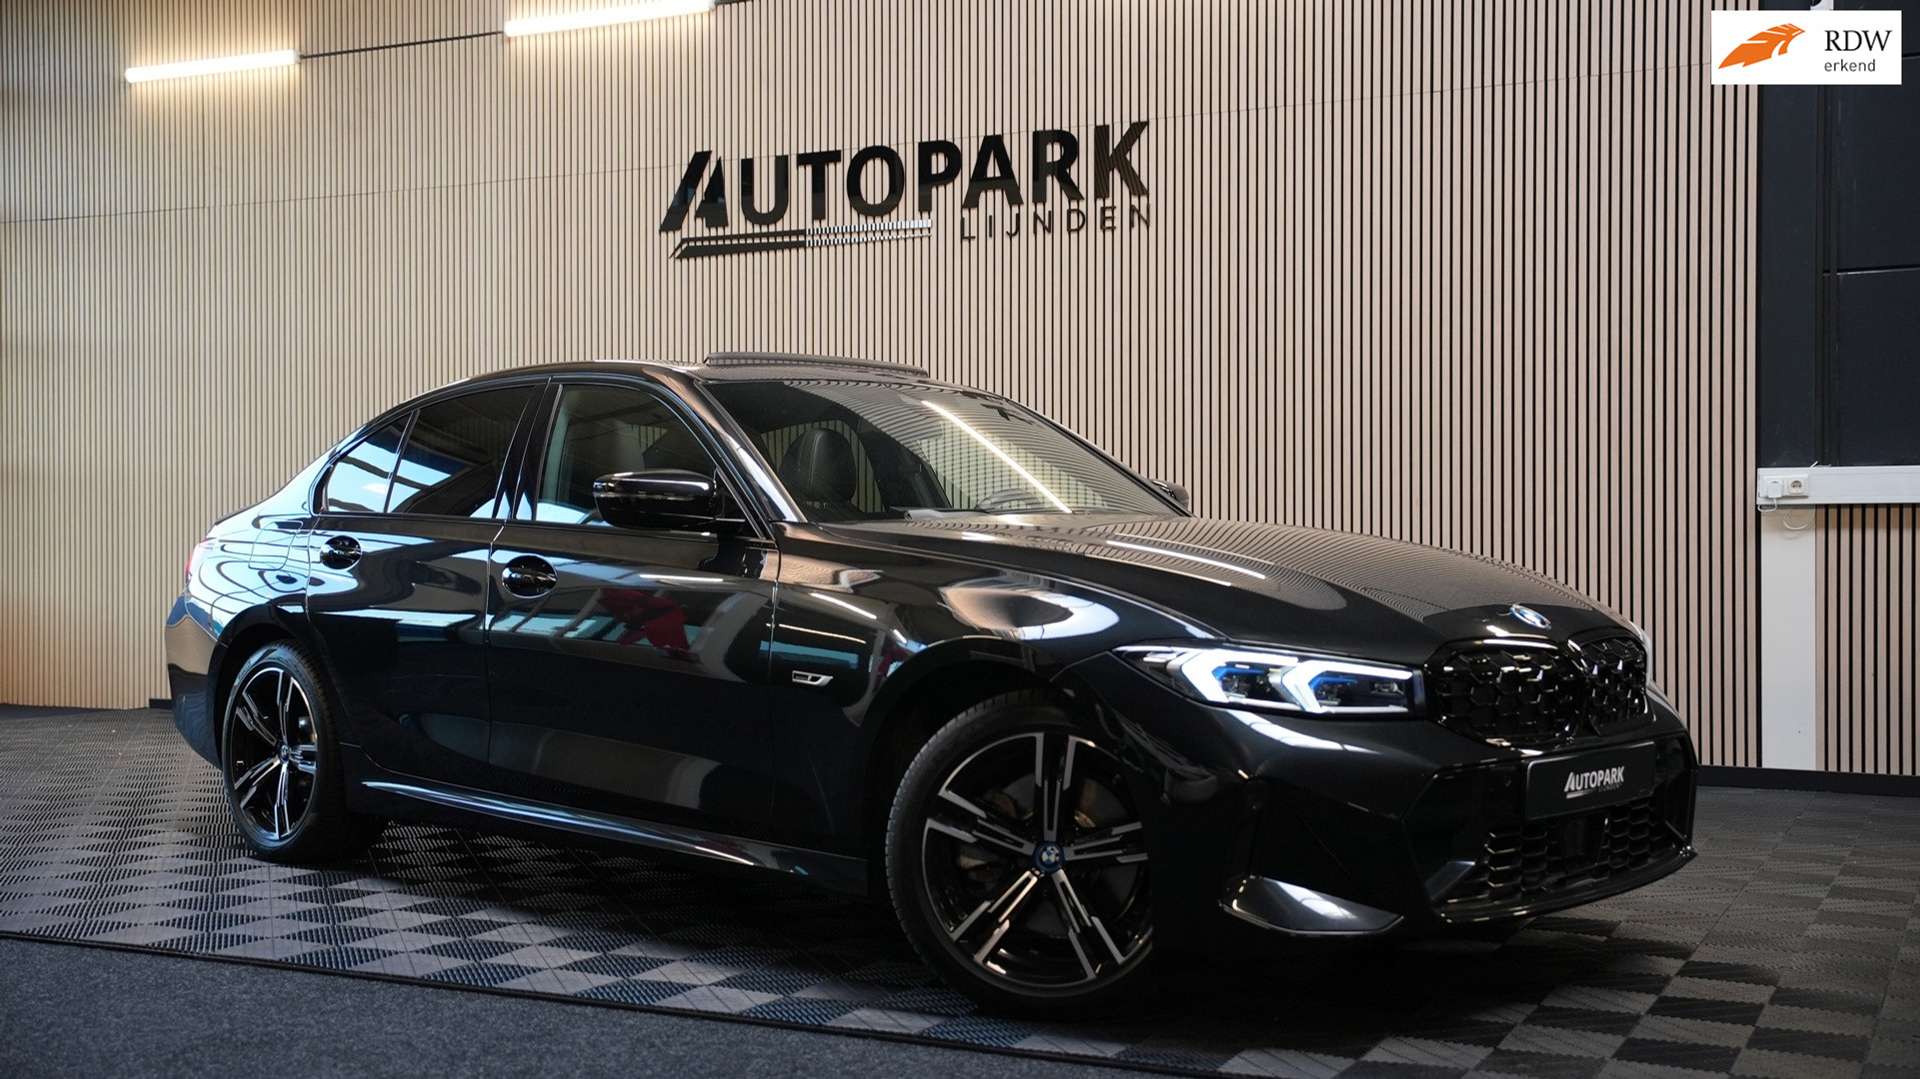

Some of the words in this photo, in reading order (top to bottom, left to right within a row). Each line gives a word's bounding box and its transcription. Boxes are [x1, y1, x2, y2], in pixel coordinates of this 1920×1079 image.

[659, 120, 1151, 233] AUTOPARK
[960, 203, 1152, 243] LIJNDEN
[1563, 765, 1625, 792] AUTOPARK
